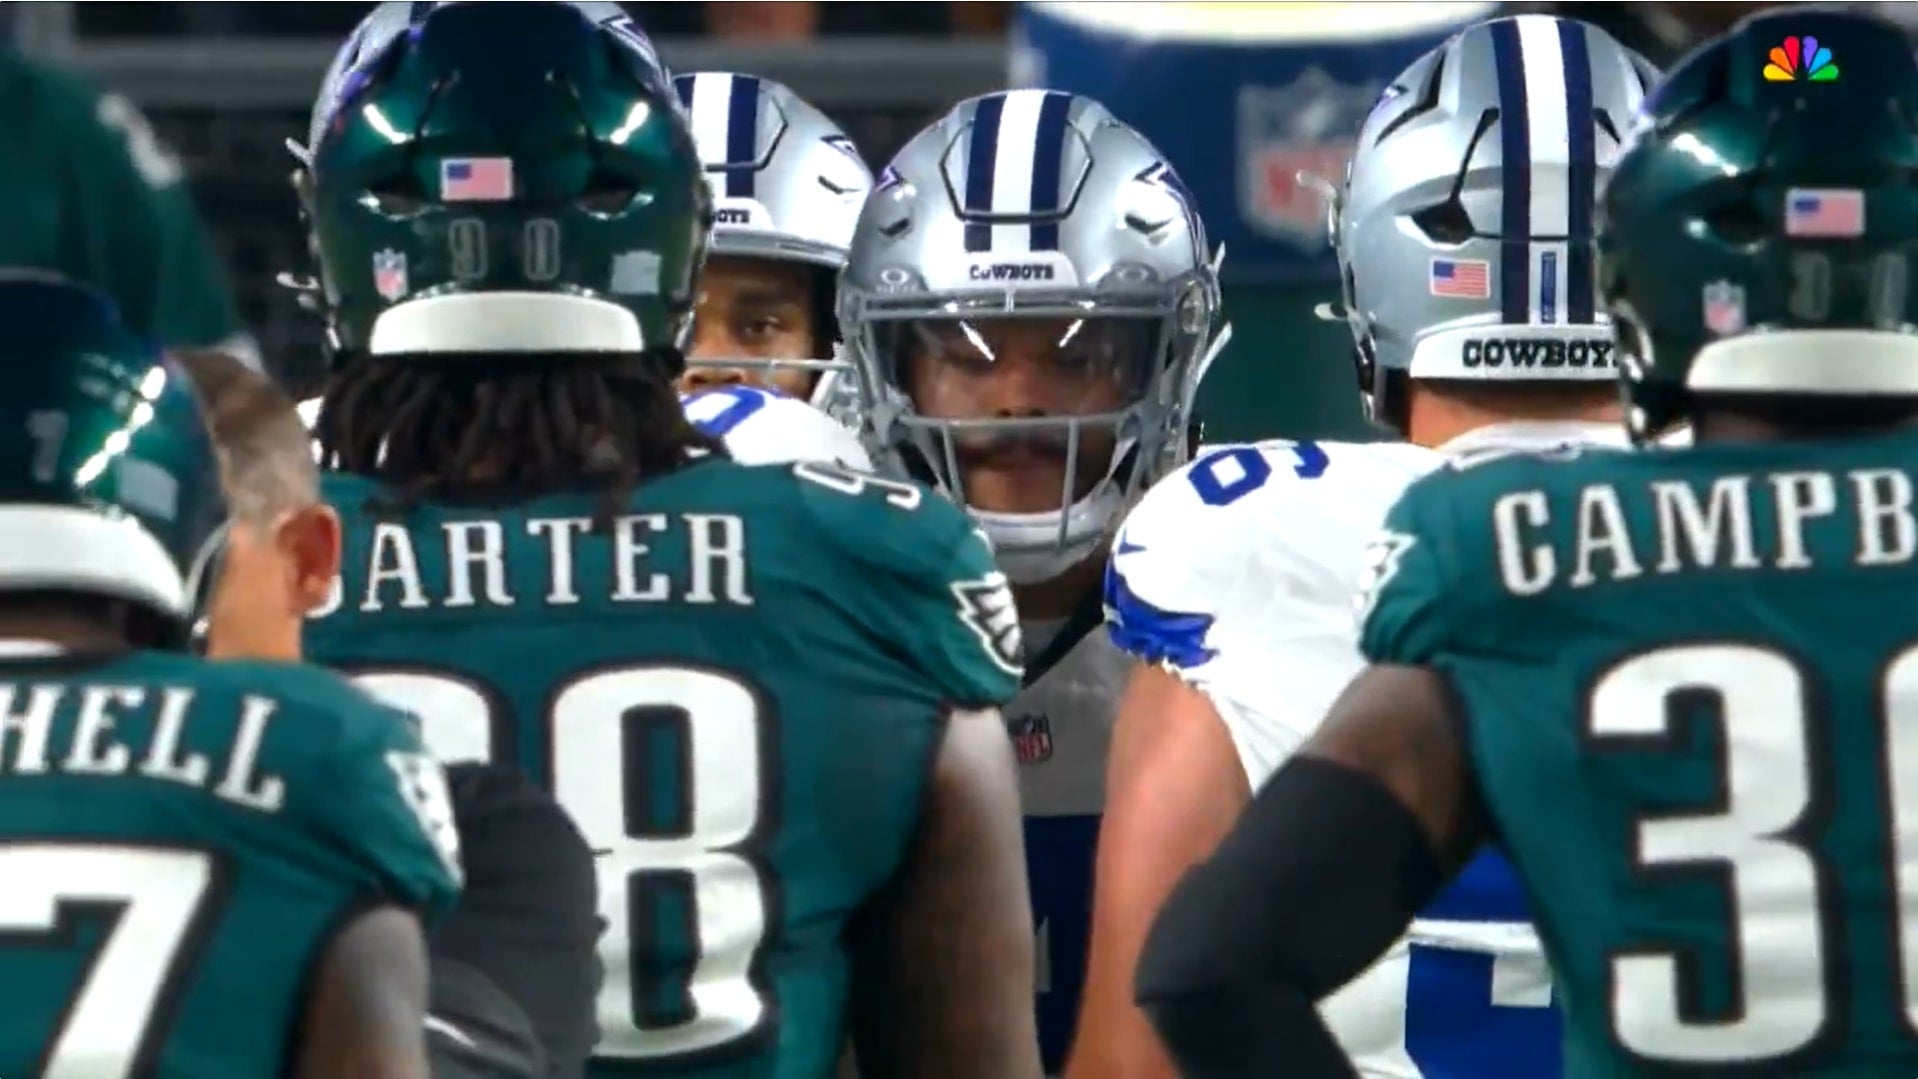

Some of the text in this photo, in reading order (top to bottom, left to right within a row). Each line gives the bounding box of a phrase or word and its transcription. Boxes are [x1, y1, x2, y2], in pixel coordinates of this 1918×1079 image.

[969, 264, 1055, 281] COWBOYS
[1462, 338, 1622, 368] COWBOY
[1590, 643, 1918, 1062] 3
